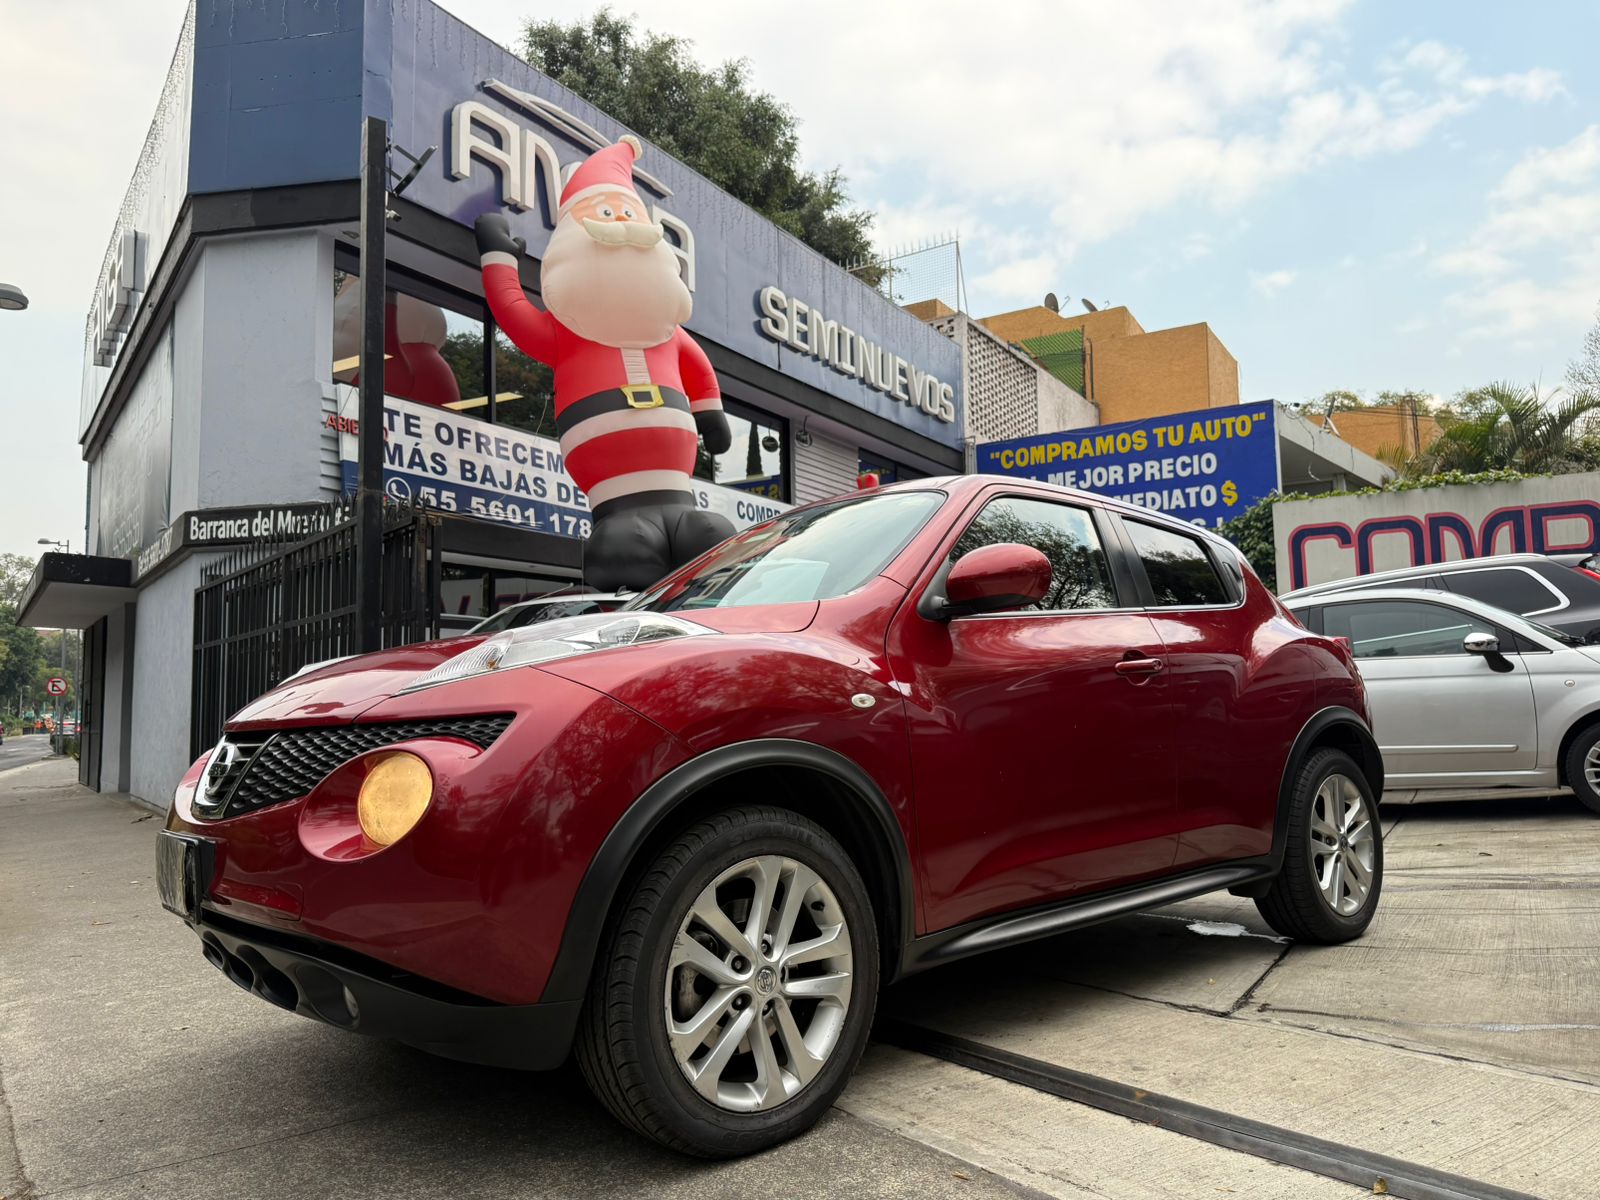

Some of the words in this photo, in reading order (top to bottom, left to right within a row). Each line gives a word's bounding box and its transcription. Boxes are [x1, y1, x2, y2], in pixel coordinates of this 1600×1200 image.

[760, 286, 955, 423] SEMINUEVOS
[384, 407, 422, 438] TE
[990, 428, 1148, 469] "COMPRAMOS
[1153, 424, 1184, 448] TU
[1189, 412, 1266, 444] AUTO"
[384, 442, 448, 476] MÁS
[459, 458, 548, 498] BAJAS
[1048, 465, 1124, 489] MEJOR
[1128, 452, 1217, 483] PRECIO
[416, 486, 457, 511] 55
[470, 496, 536, 527] 5601
[1221, 480, 1238, 506] $
[189, 516, 249, 540] Barranca
[252, 509, 273, 537] del
